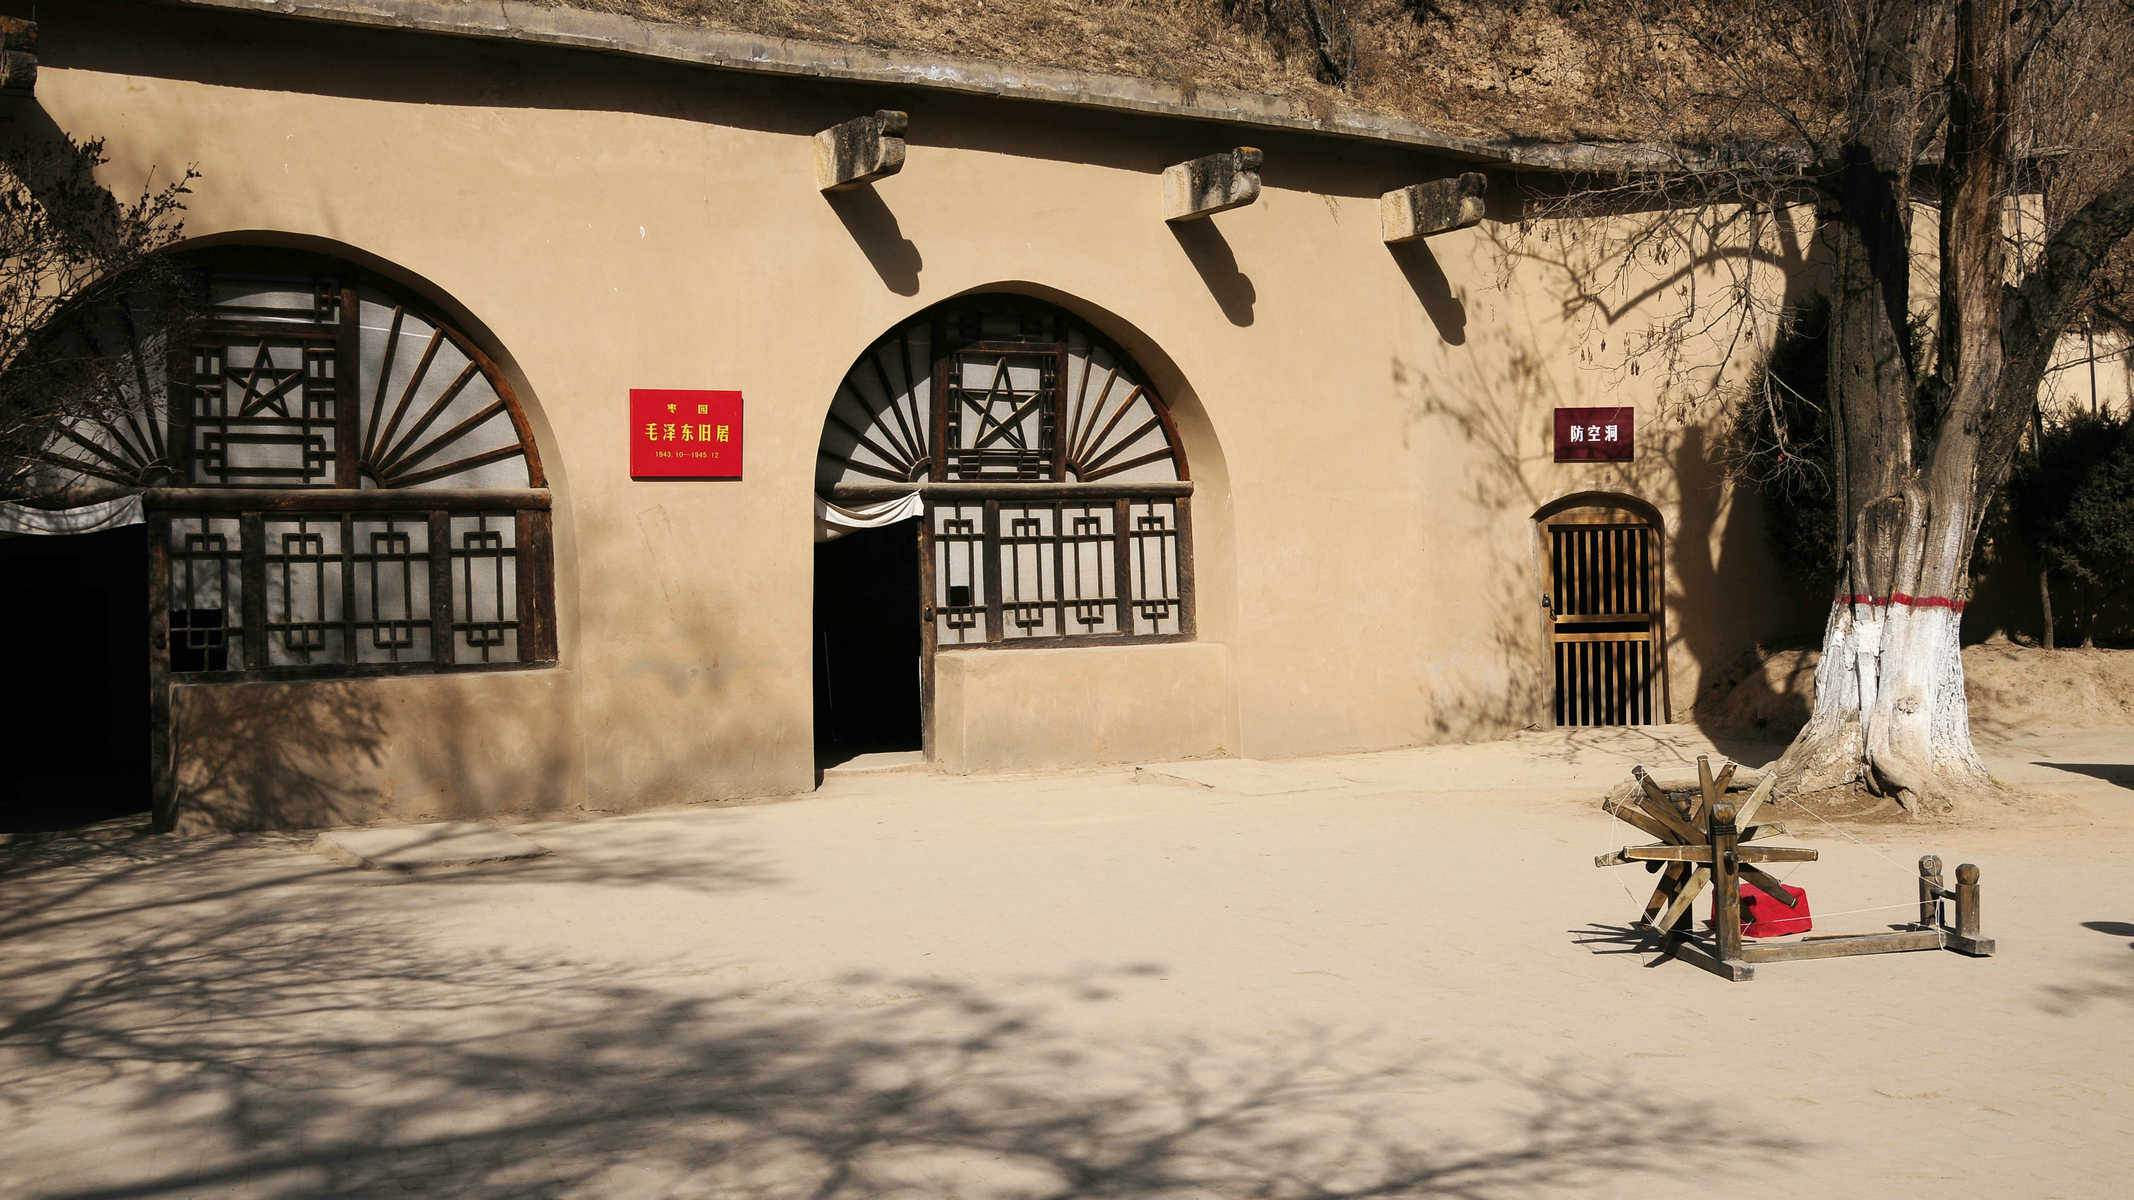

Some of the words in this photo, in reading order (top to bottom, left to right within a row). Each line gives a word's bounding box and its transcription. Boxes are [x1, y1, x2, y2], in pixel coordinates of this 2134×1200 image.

[645, 423, 729, 443] 毛泽东旧居
[1570, 424, 1618, 443] 防空洞
